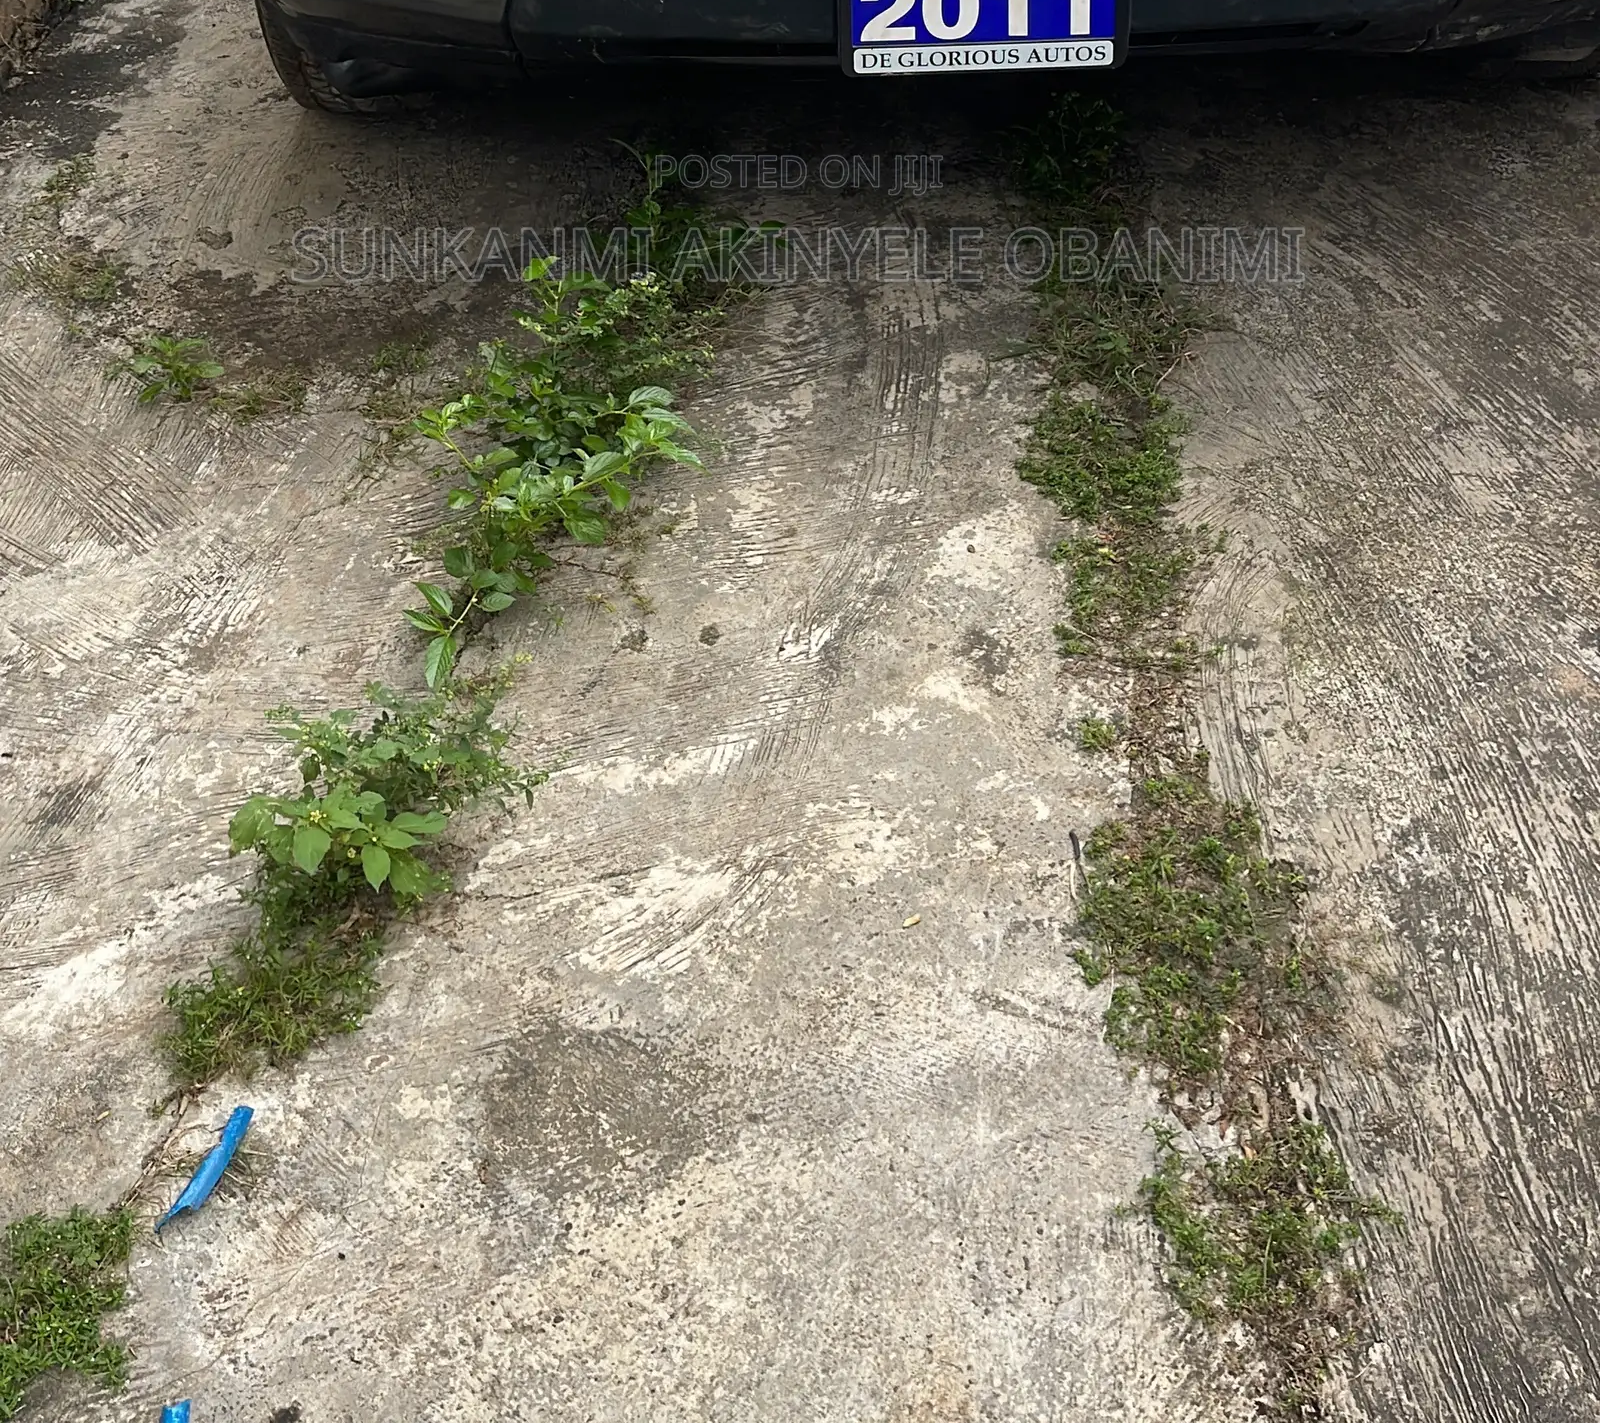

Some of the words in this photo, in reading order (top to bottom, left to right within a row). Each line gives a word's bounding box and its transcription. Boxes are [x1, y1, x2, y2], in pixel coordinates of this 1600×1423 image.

[861, 53, 892, 69] DE
[898, 48, 1020, 67] GLORIOUS
[1026, 45, 1107, 64] AUTOS
